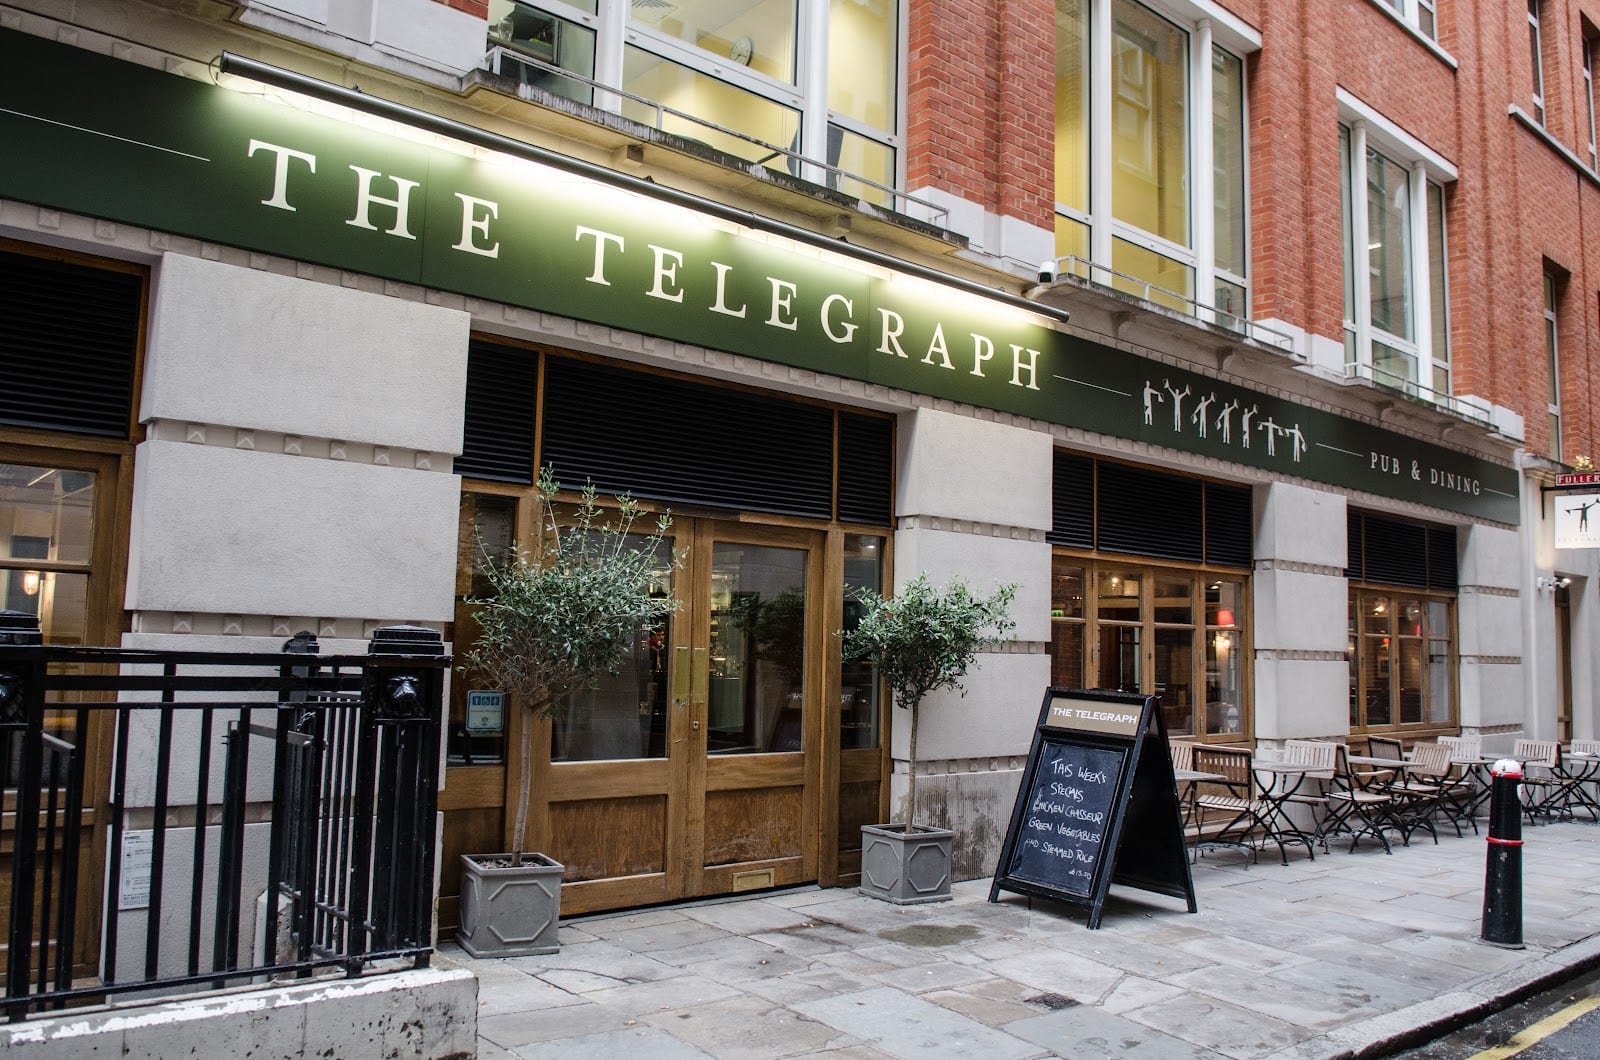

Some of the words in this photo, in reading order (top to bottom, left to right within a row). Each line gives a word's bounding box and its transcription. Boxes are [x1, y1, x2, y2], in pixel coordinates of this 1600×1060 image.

[248, 138, 500, 259] THE
[575, 225, 1041, 391] TELEGRAPH
[1370, 452, 1400, 475] PUB
[1411, 460, 1420, 481] &
[1430, 468, 1480, 496] DINING
[1053, 707, 1072, 717] THE
[1075, 709, 1138, 724] TELEGRAPH
[1028, 816, 1053, 831] GREEN
[1057, 822, 1100, 843] VEGETABLES
